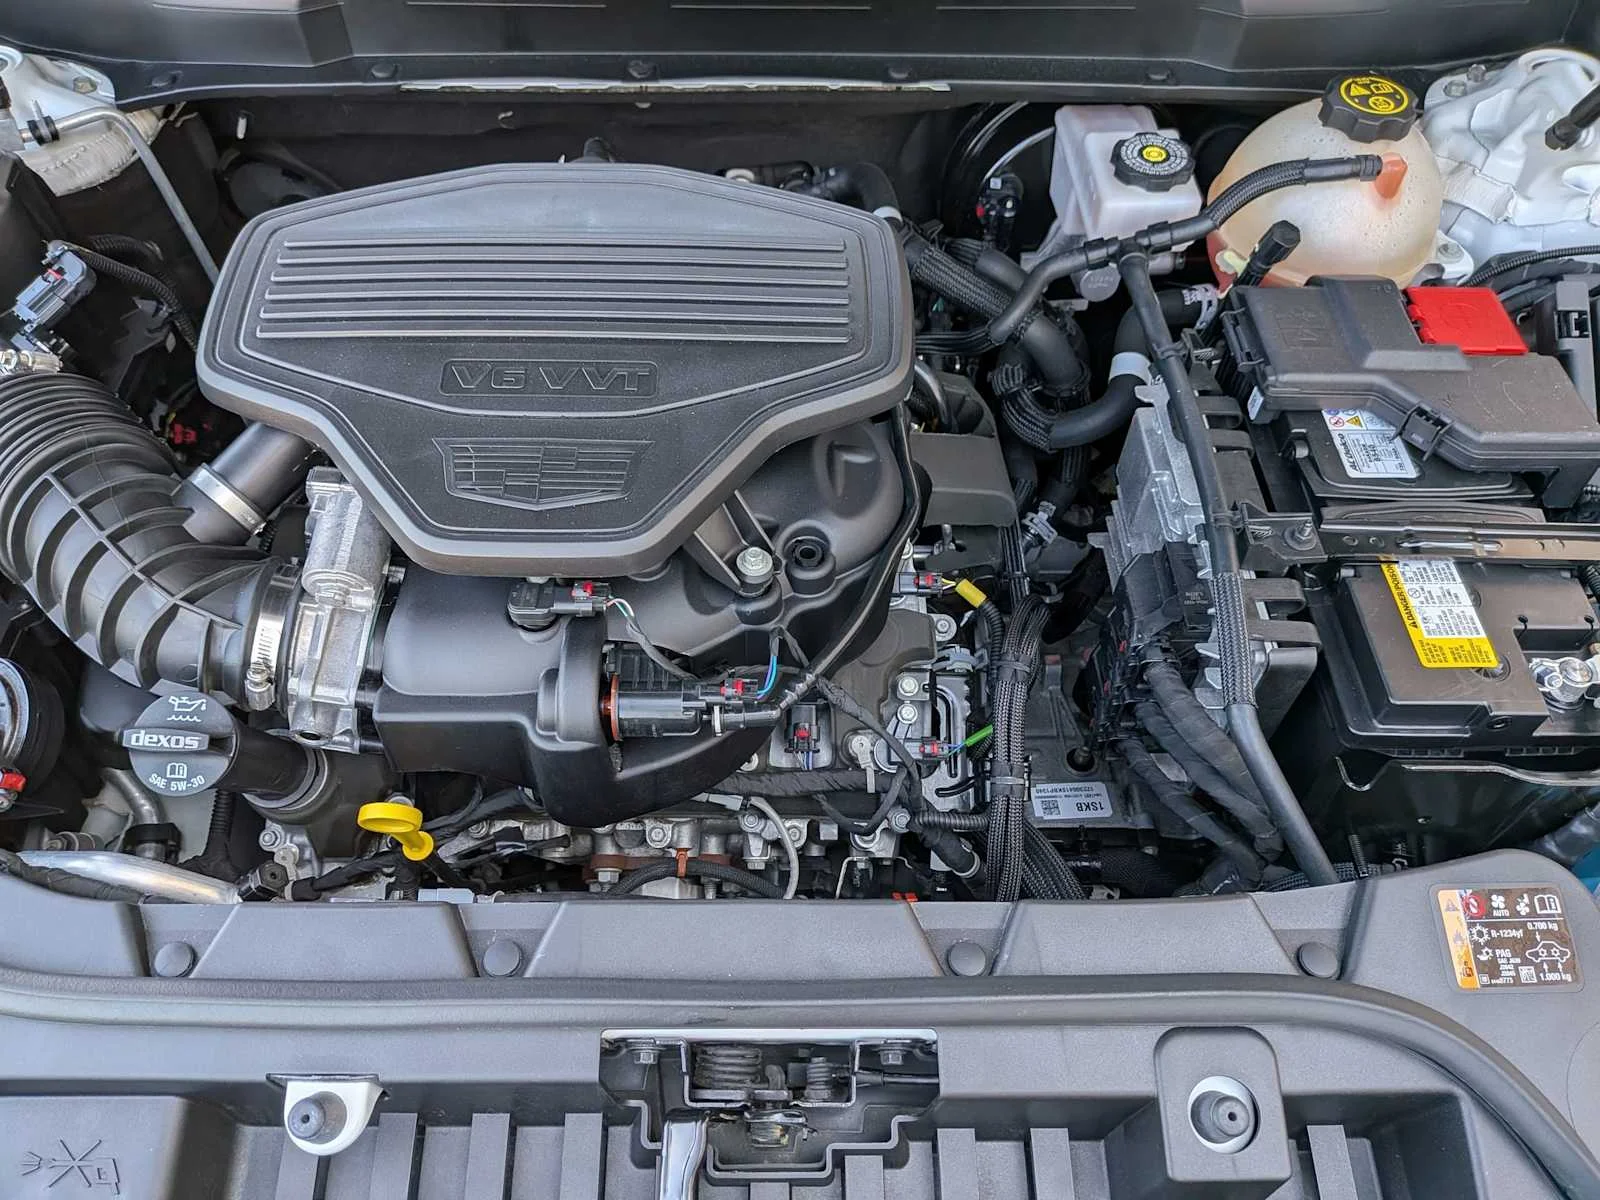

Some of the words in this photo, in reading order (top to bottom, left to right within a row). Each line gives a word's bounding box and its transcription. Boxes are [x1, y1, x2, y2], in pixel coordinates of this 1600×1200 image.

[451, 364, 525, 389] V6
[538, 366, 650, 391] VVT
[131, 730, 202, 749] dexos
[149, 773, 167, 789] SAE
[170, 776, 205, 791] 5W-30
[1075, 801, 1105, 812] 1SKB
[1493, 909, 1510, 917] AUTO
[1527, 922, 1547, 930] 0.700
[1548, 922, 1559, 931] kg
[1490, 929, 1524, 939] R-1234yf
[1495, 949, 1512, 958] PAG
[1540, 972, 1561, 981] 1.000
[1561, 972, 1572, 982] kg
